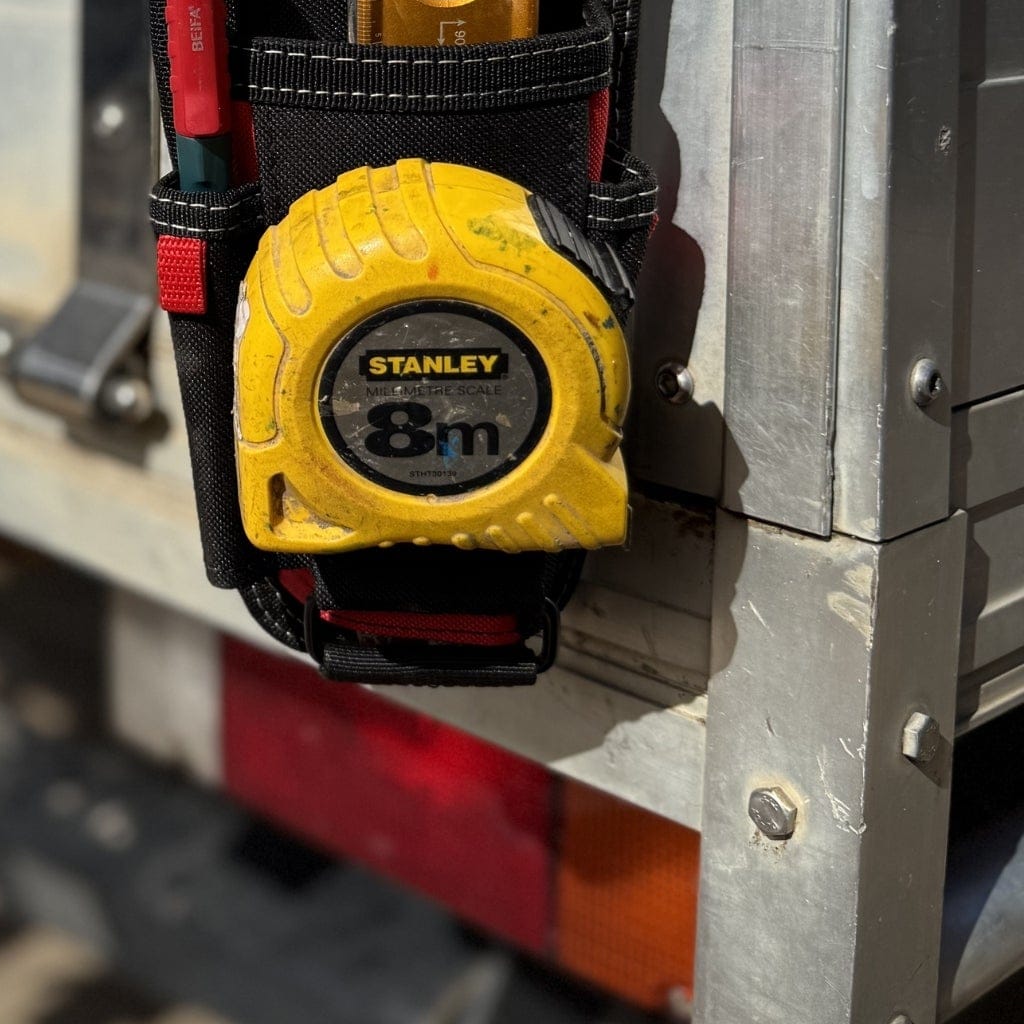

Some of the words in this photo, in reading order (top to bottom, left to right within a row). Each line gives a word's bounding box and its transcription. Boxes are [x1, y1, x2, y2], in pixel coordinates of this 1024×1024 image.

[454, 30, 466, 46] 90
[368, 354, 499, 375] STANLEY
[457, 384, 503, 396] SCALE
[364, 401, 500, 458] 8m
